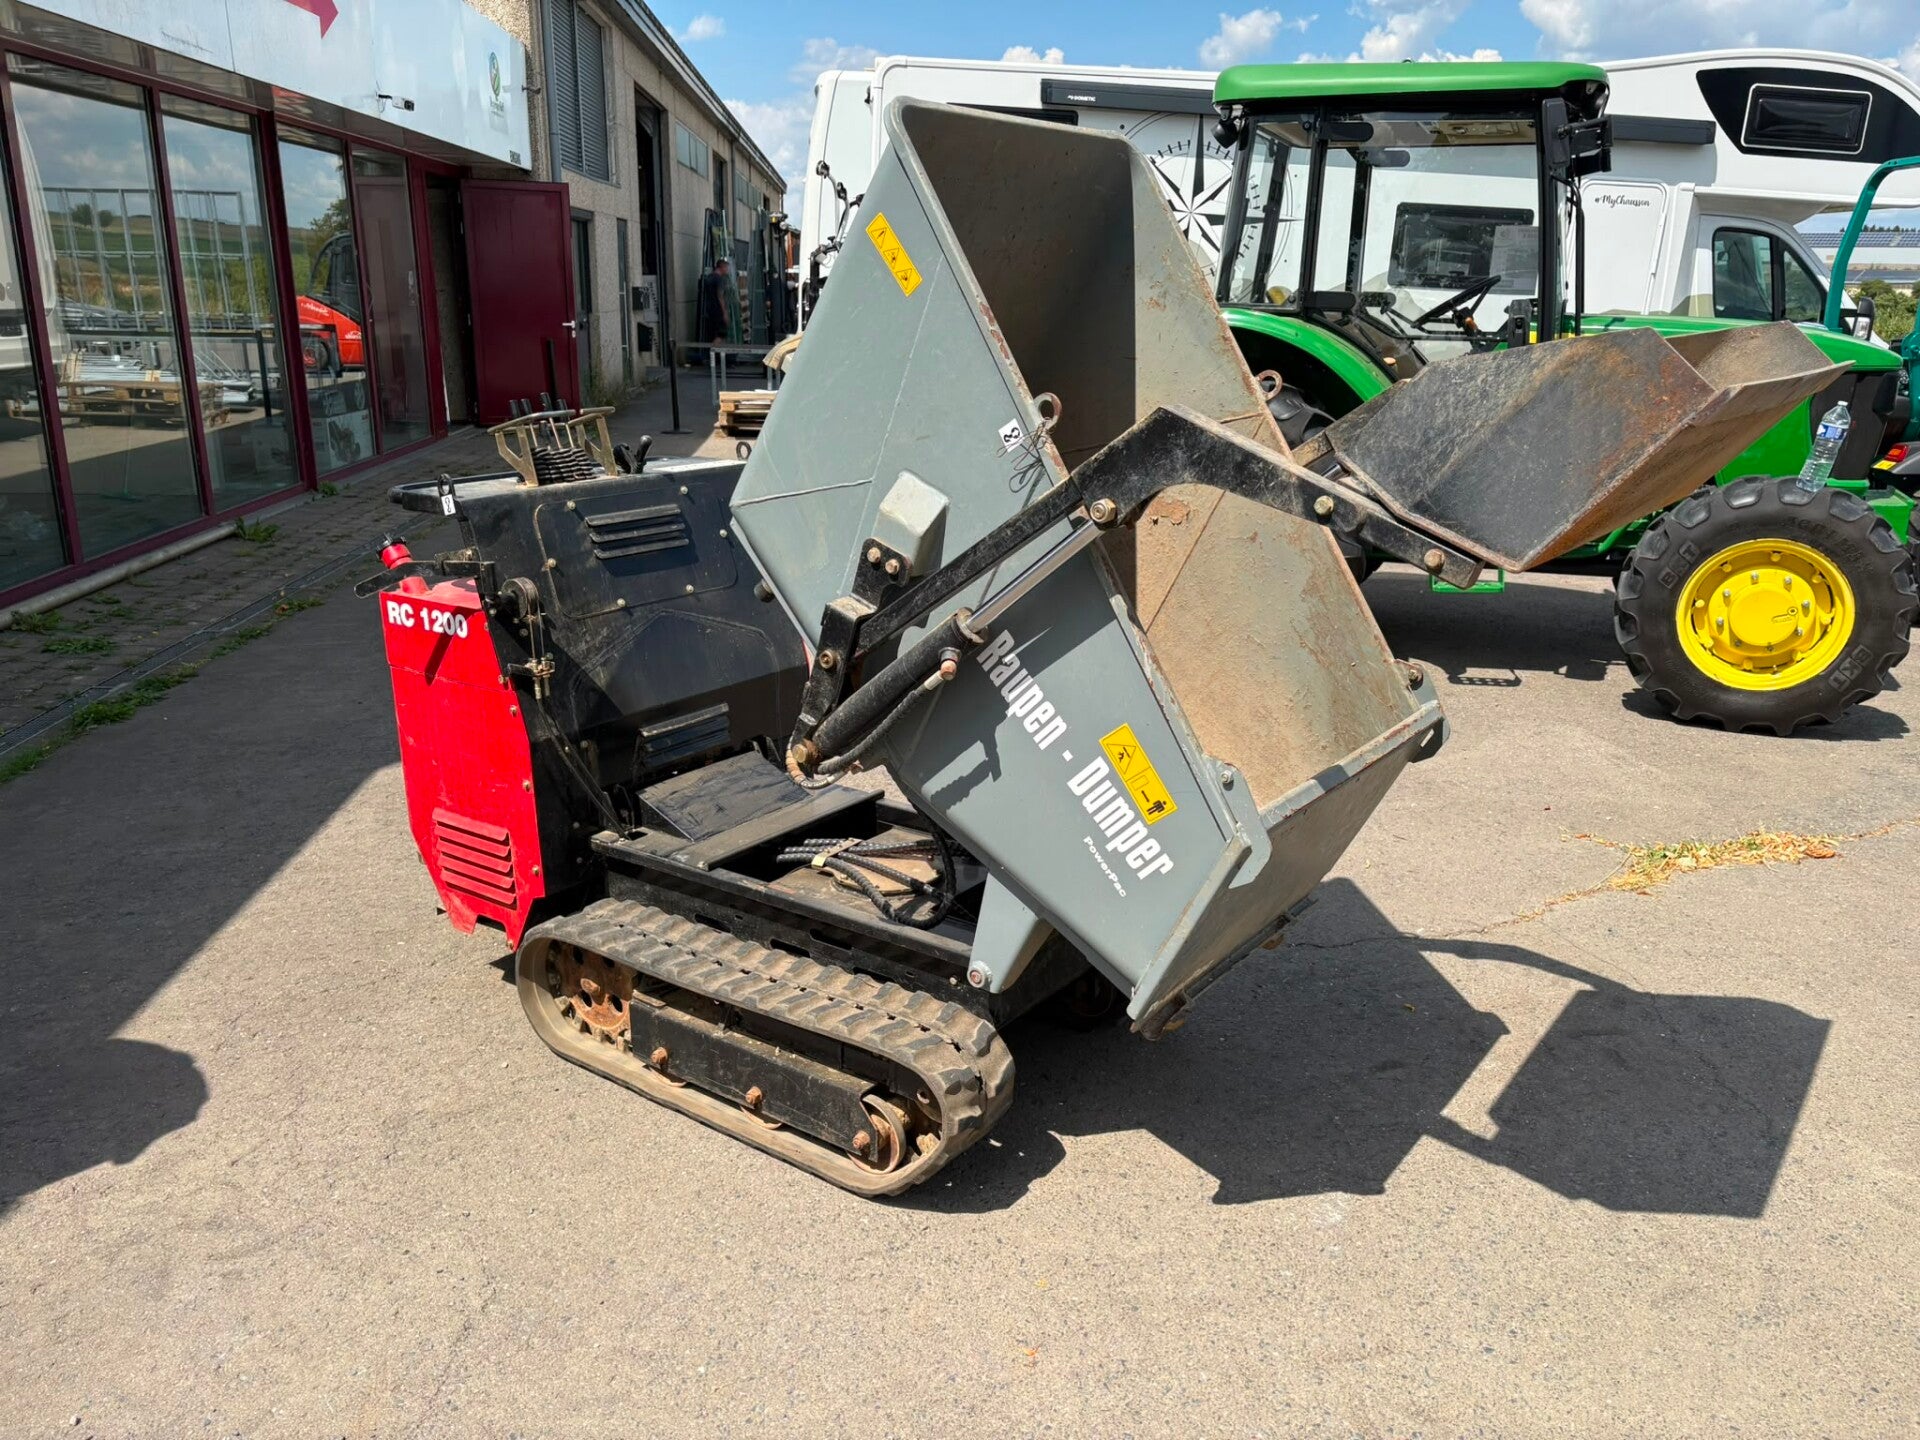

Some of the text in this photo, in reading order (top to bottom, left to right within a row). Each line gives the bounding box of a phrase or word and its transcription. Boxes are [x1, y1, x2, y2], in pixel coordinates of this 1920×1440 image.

[386, 600, 468, 639] RC 1200
[976, 629, 1068, 750] Raupen
[1066, 756, 1174, 880] Dumper
[1082, 835, 1127, 898] PowerPac
